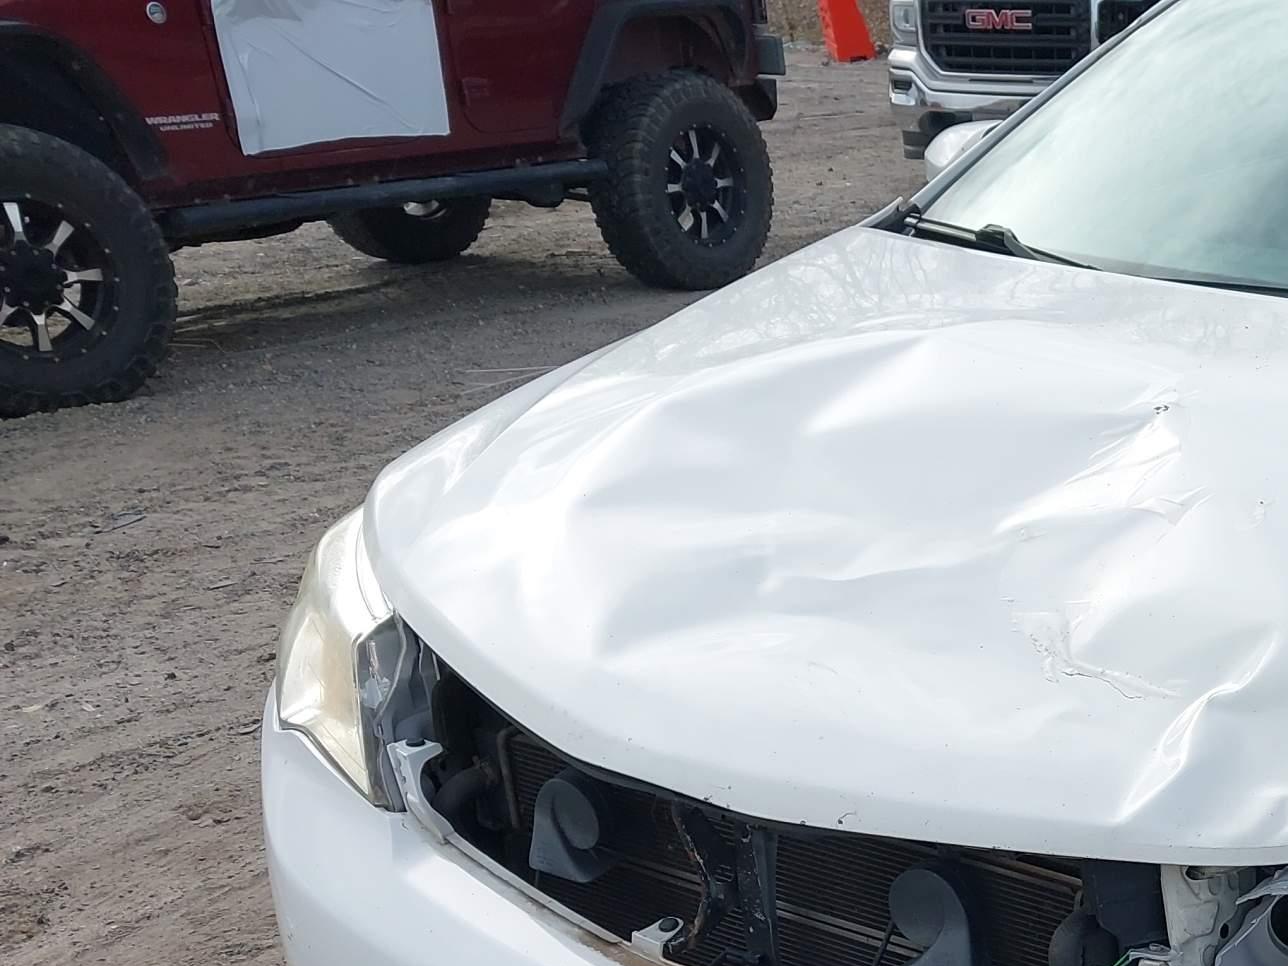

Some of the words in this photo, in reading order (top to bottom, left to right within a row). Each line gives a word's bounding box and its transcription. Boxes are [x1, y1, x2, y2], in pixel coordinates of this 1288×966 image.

[965, 8, 1032, 30] GMC
[144, 112, 221, 125] WRANGLER
[159, 121, 214, 132] UNLIMITED
